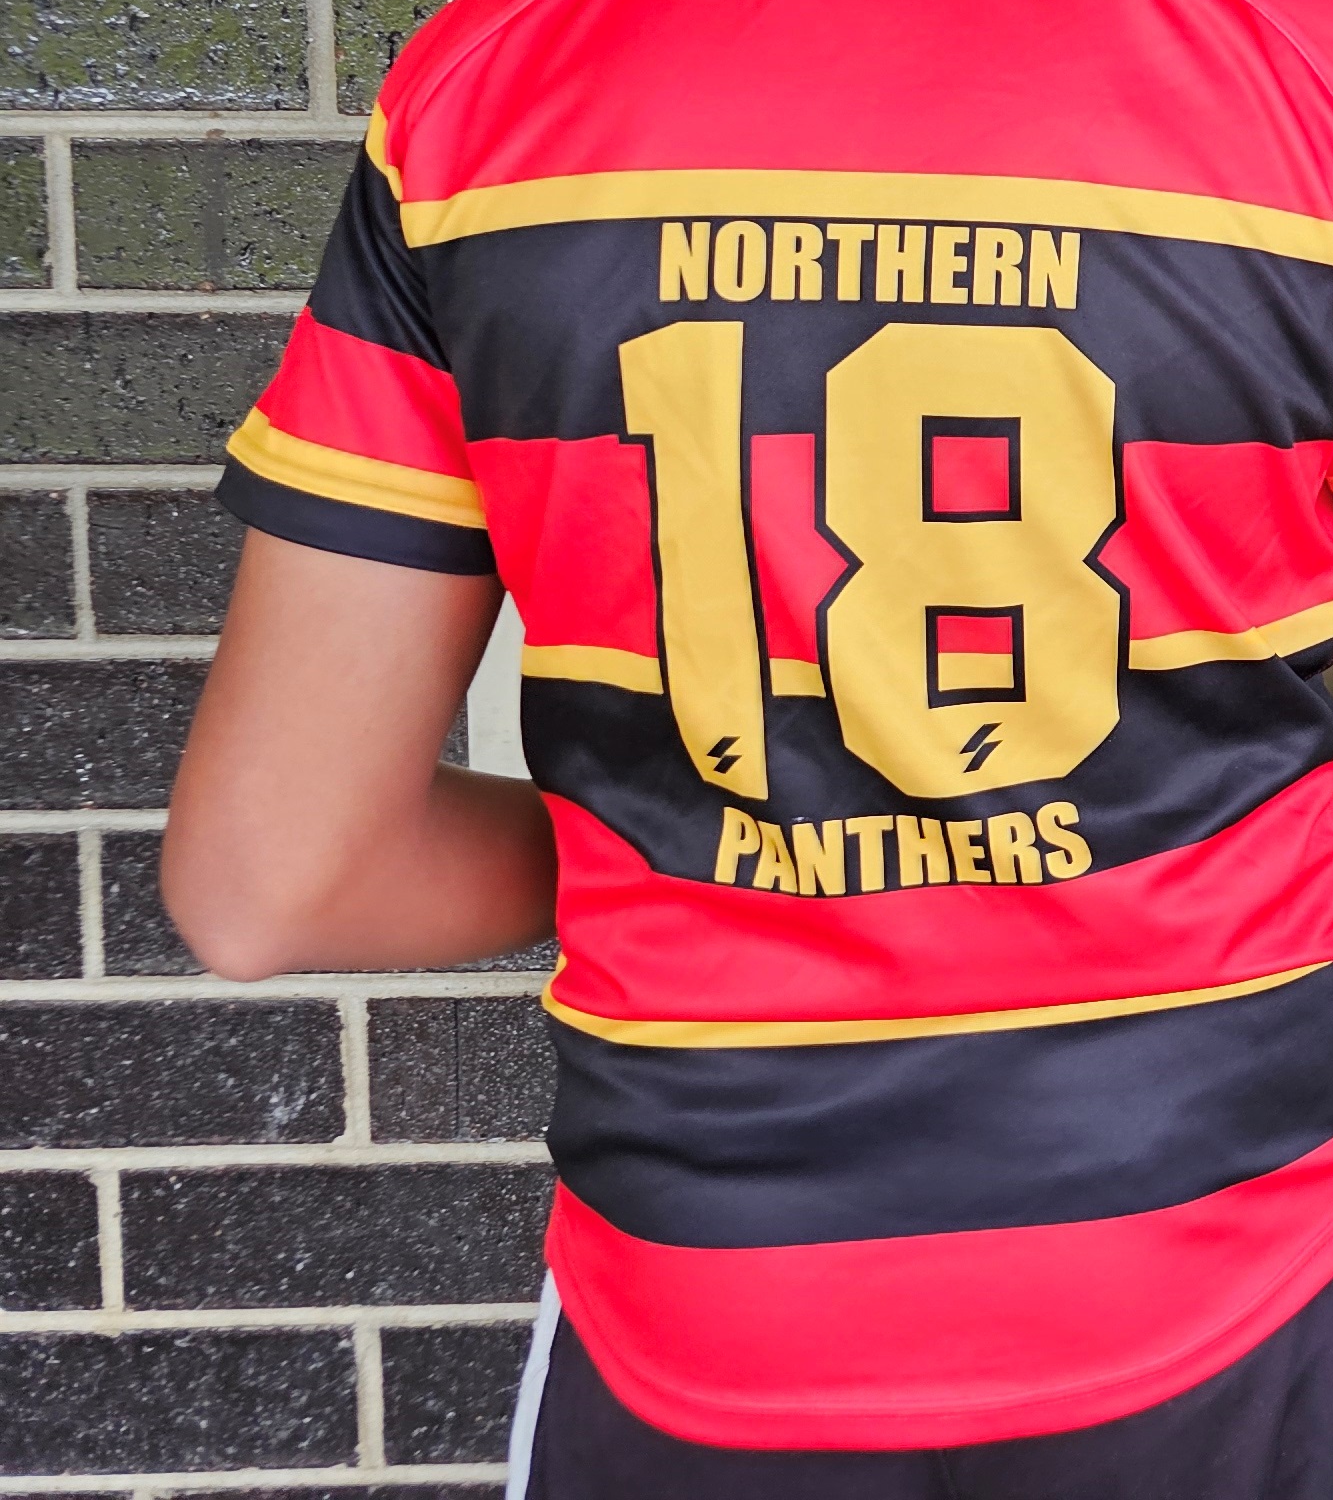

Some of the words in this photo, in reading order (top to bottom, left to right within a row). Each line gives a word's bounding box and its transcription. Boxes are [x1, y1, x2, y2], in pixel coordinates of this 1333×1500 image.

[660, 221, 1081, 310] NORTHERN
[617, 320, 1122, 801] 18
[713, 801, 1094, 897] PANTHERS
